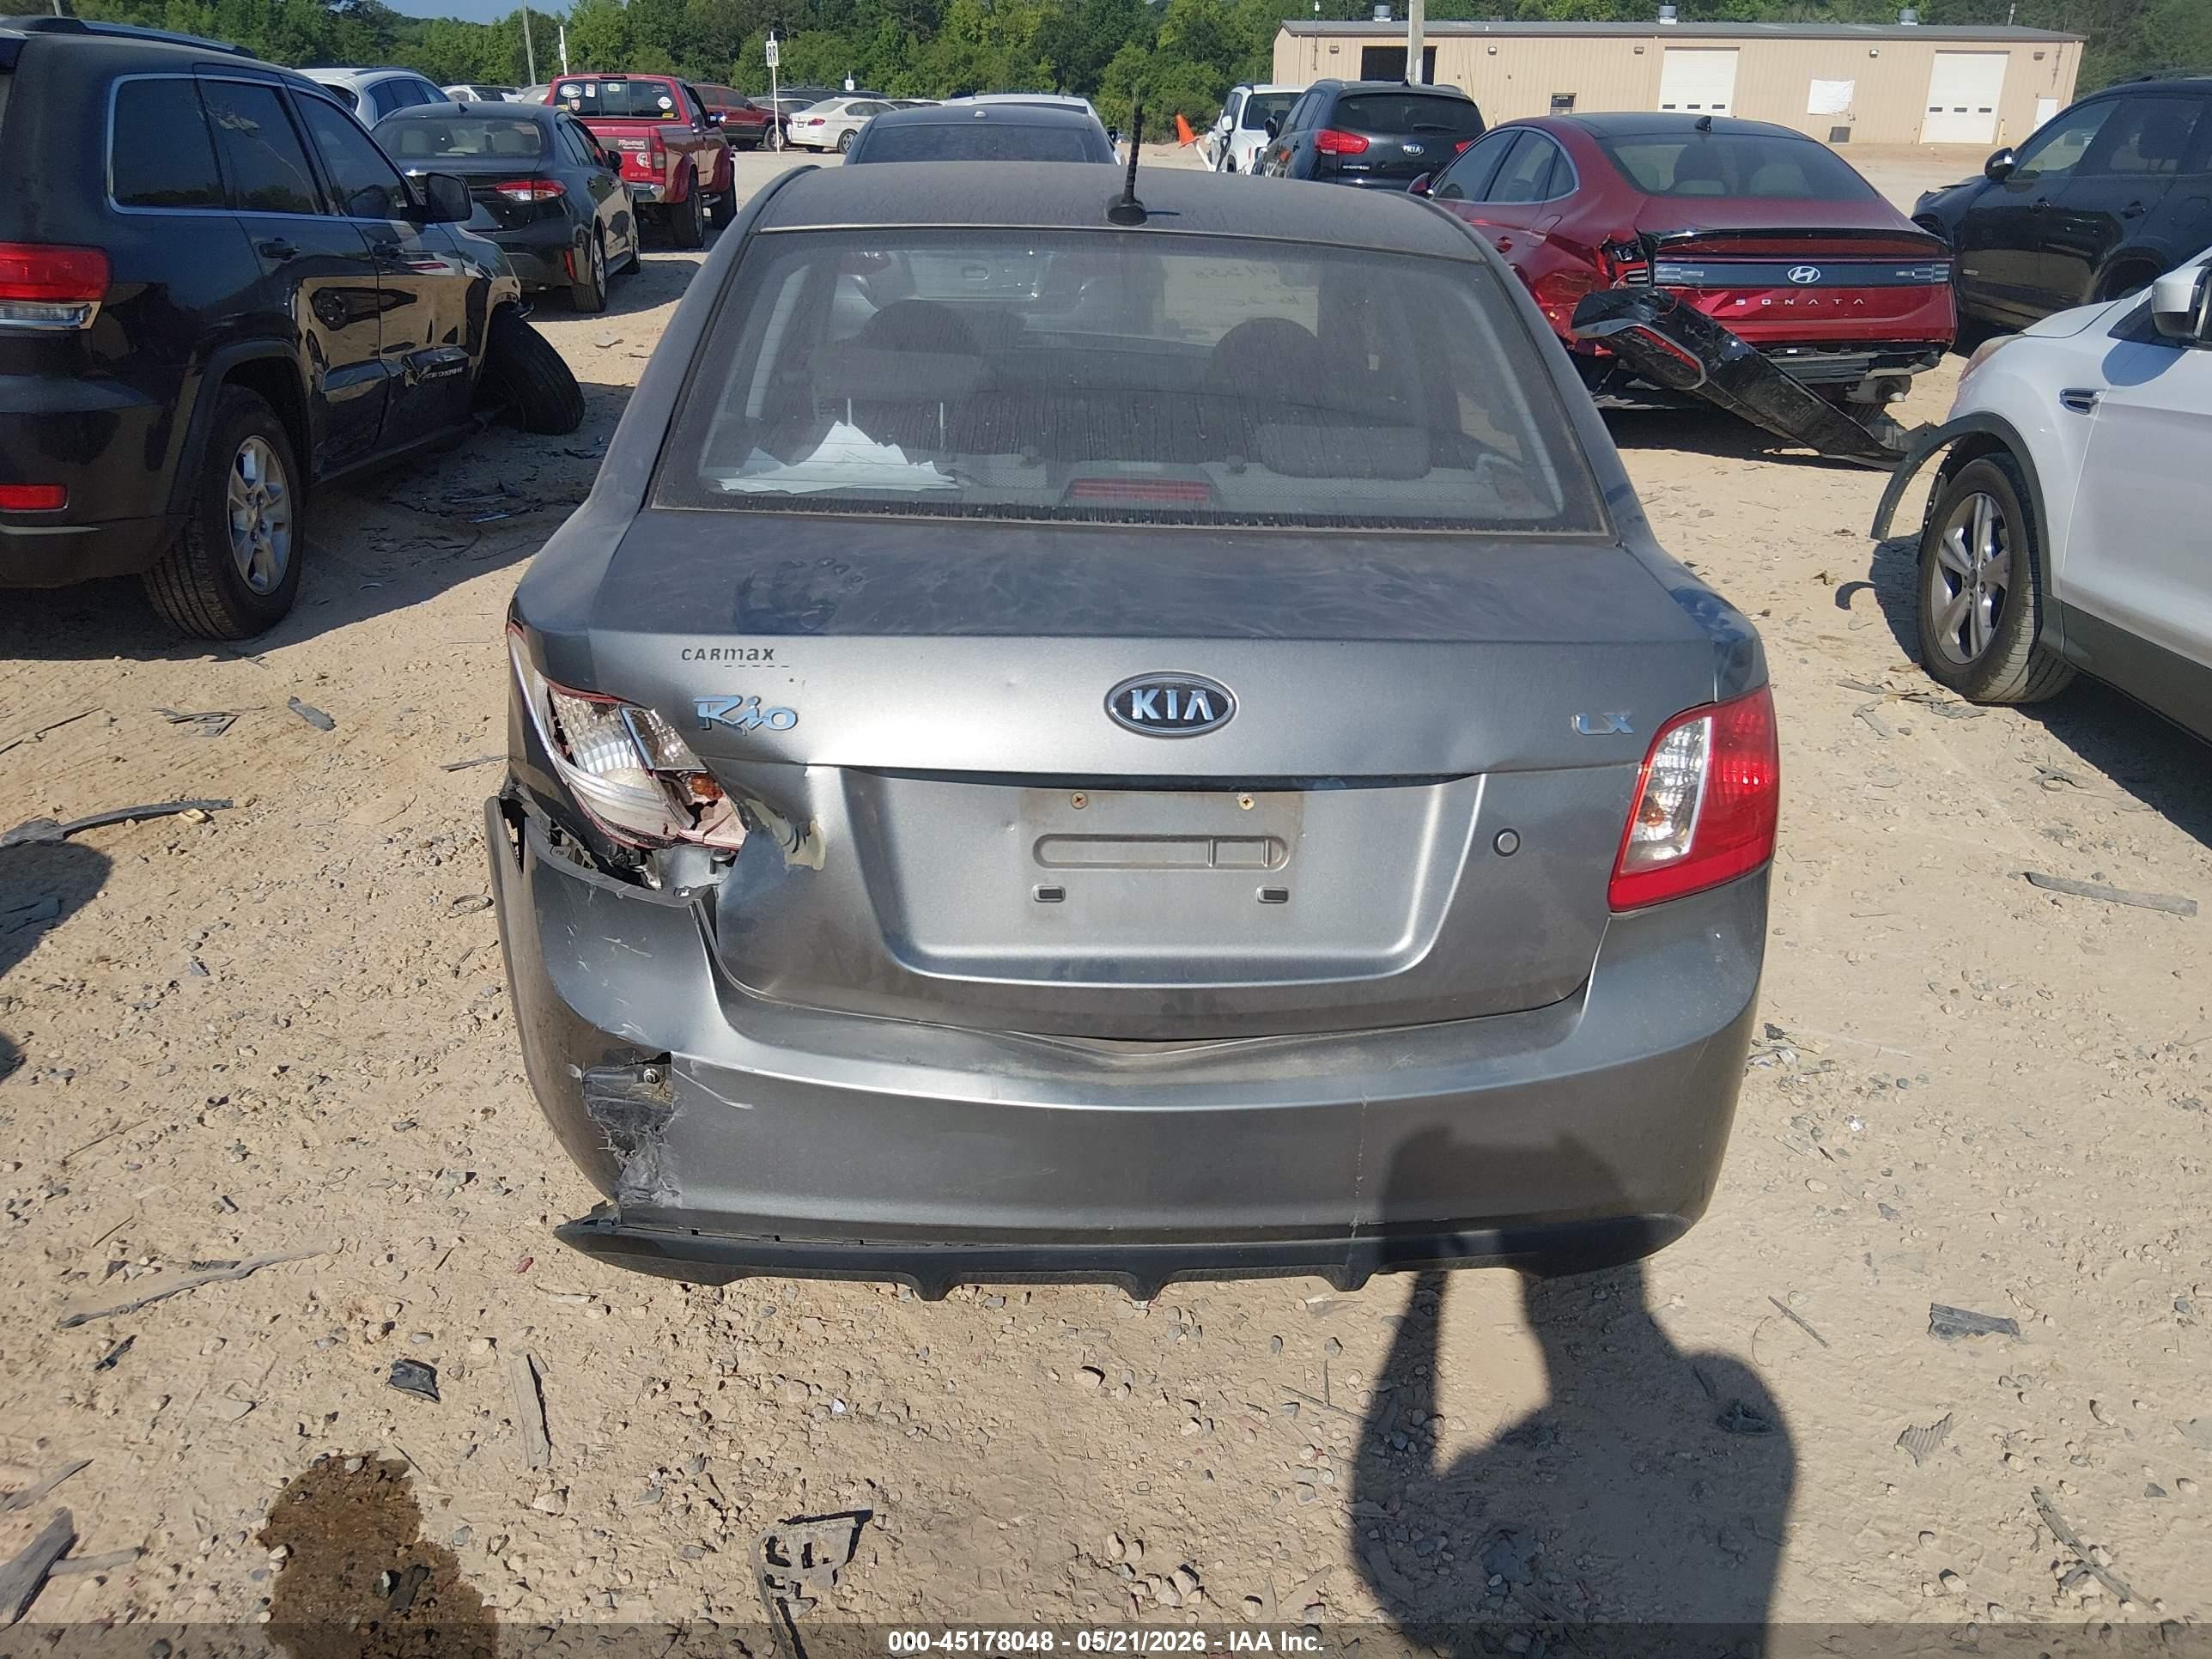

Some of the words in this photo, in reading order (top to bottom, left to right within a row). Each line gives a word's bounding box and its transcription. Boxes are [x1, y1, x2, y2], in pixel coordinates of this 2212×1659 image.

[693, 694, 799, 735] Rio
[1130, 689, 1215, 720] KIA
[1571, 713, 1636, 736] LX
